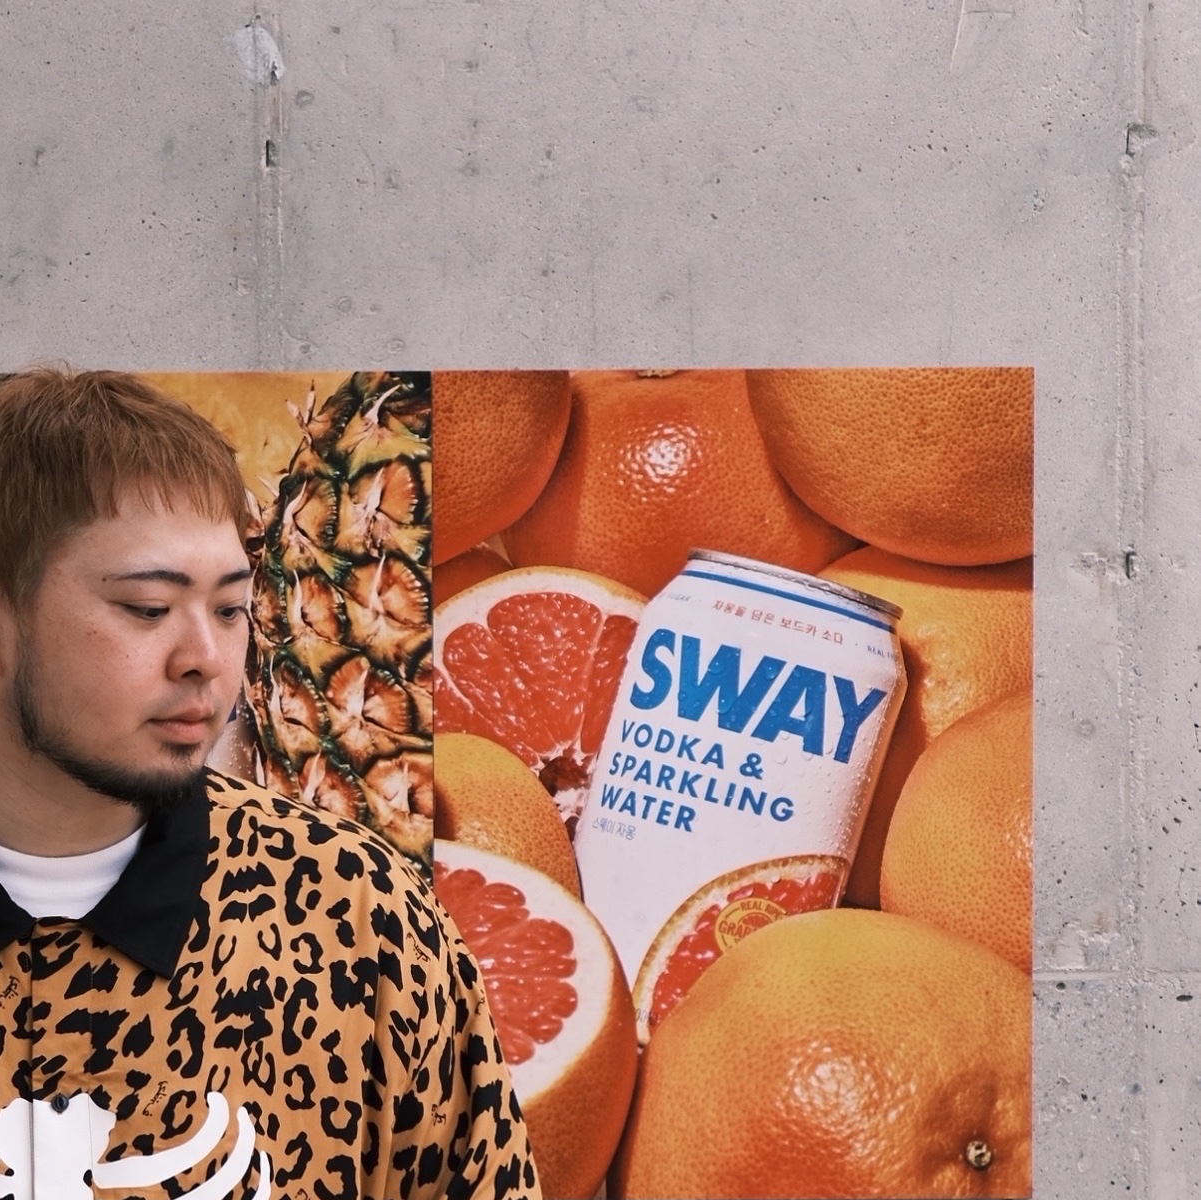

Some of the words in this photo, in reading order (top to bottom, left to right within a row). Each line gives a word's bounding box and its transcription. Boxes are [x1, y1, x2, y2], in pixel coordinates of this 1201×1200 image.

[712, 600, 748, 617] 자몽을
[751, 610, 777, 624] 담은
[780, 617, 817, 637] 보드카
[822, 630, 844, 645] 소다
[630, 628, 887, 764] SWAY
[622, 719, 725, 770] VODKA
[739, 753, 764, 780] &
[601, 784, 696, 832] WATER
[609, 752, 794, 822] SPARKLING
[617, 822, 636, 841] 자몽
[740, 901, 764, 911] REAL
